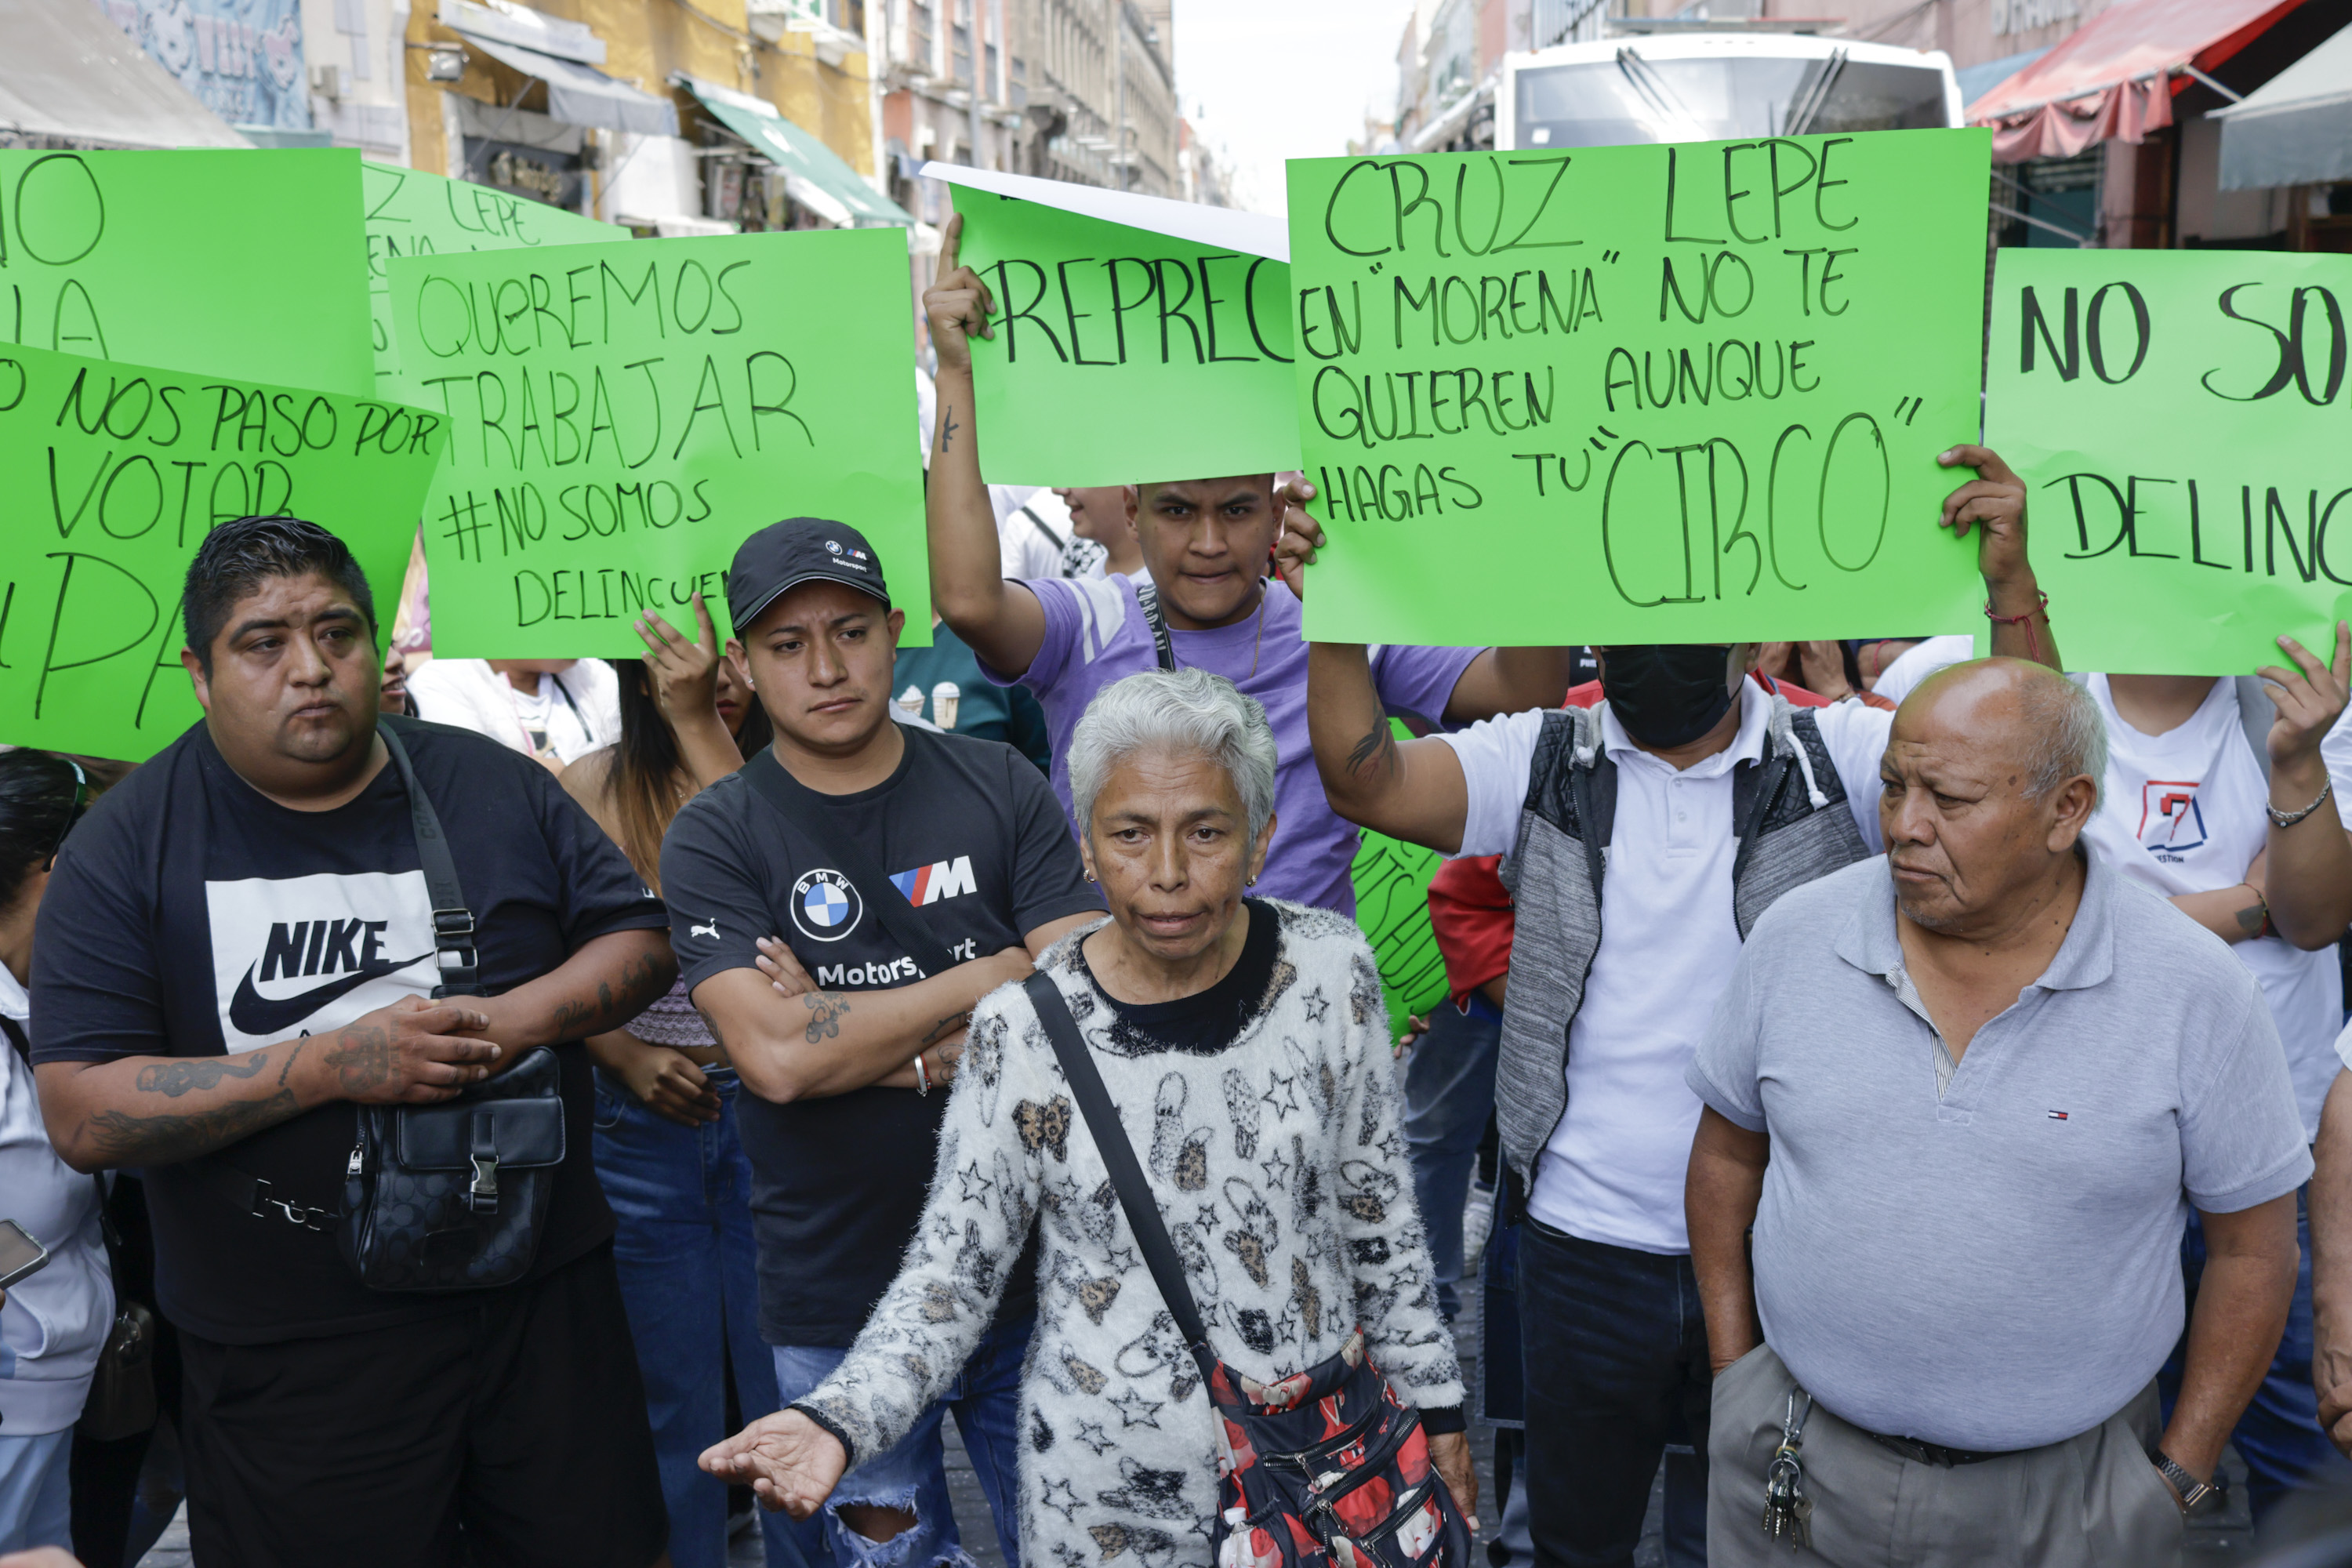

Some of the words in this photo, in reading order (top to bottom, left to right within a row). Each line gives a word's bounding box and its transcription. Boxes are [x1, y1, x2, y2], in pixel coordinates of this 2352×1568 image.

[445, 179, 543, 247] LEPE
[1325, 155, 1584, 258] CRUZ
[1664, 137, 1859, 245] LEPE
[1299, 280, 1362, 361] EN
[1370, 249, 1621, 348] "MORENA"
[1659, 250, 1754, 325] NO
[1783, 247, 1859, 317] TE
[2018, 280, 2153, 386] NO
[2200, 280, 2352, 407] SO
[55, 365, 187, 448] NOS
[201, 384, 339, 458] PASO
[353, 400, 441, 457] POR
[420, 350, 817, 472] TRABAJAR
[1312, 365, 1554, 449] QUIEREN
[1604, 339, 1820, 412] AUNQUE
[47, 446, 295, 548] VOTAR
[1317, 463, 1485, 524] HAGAS
[1510, 445, 1591, 499] TU
[1588, 394, 1926, 608] "CIRCO"
[833, 557, 867, 572] Motorsport
[797, 872, 851, 895] BMW
[922, 855, 978, 906] M
[2156, 855, 2183, 863] ESTION
[258, 916, 391, 983] NIKE
[817, 937, 978, 987] Motorsrt
